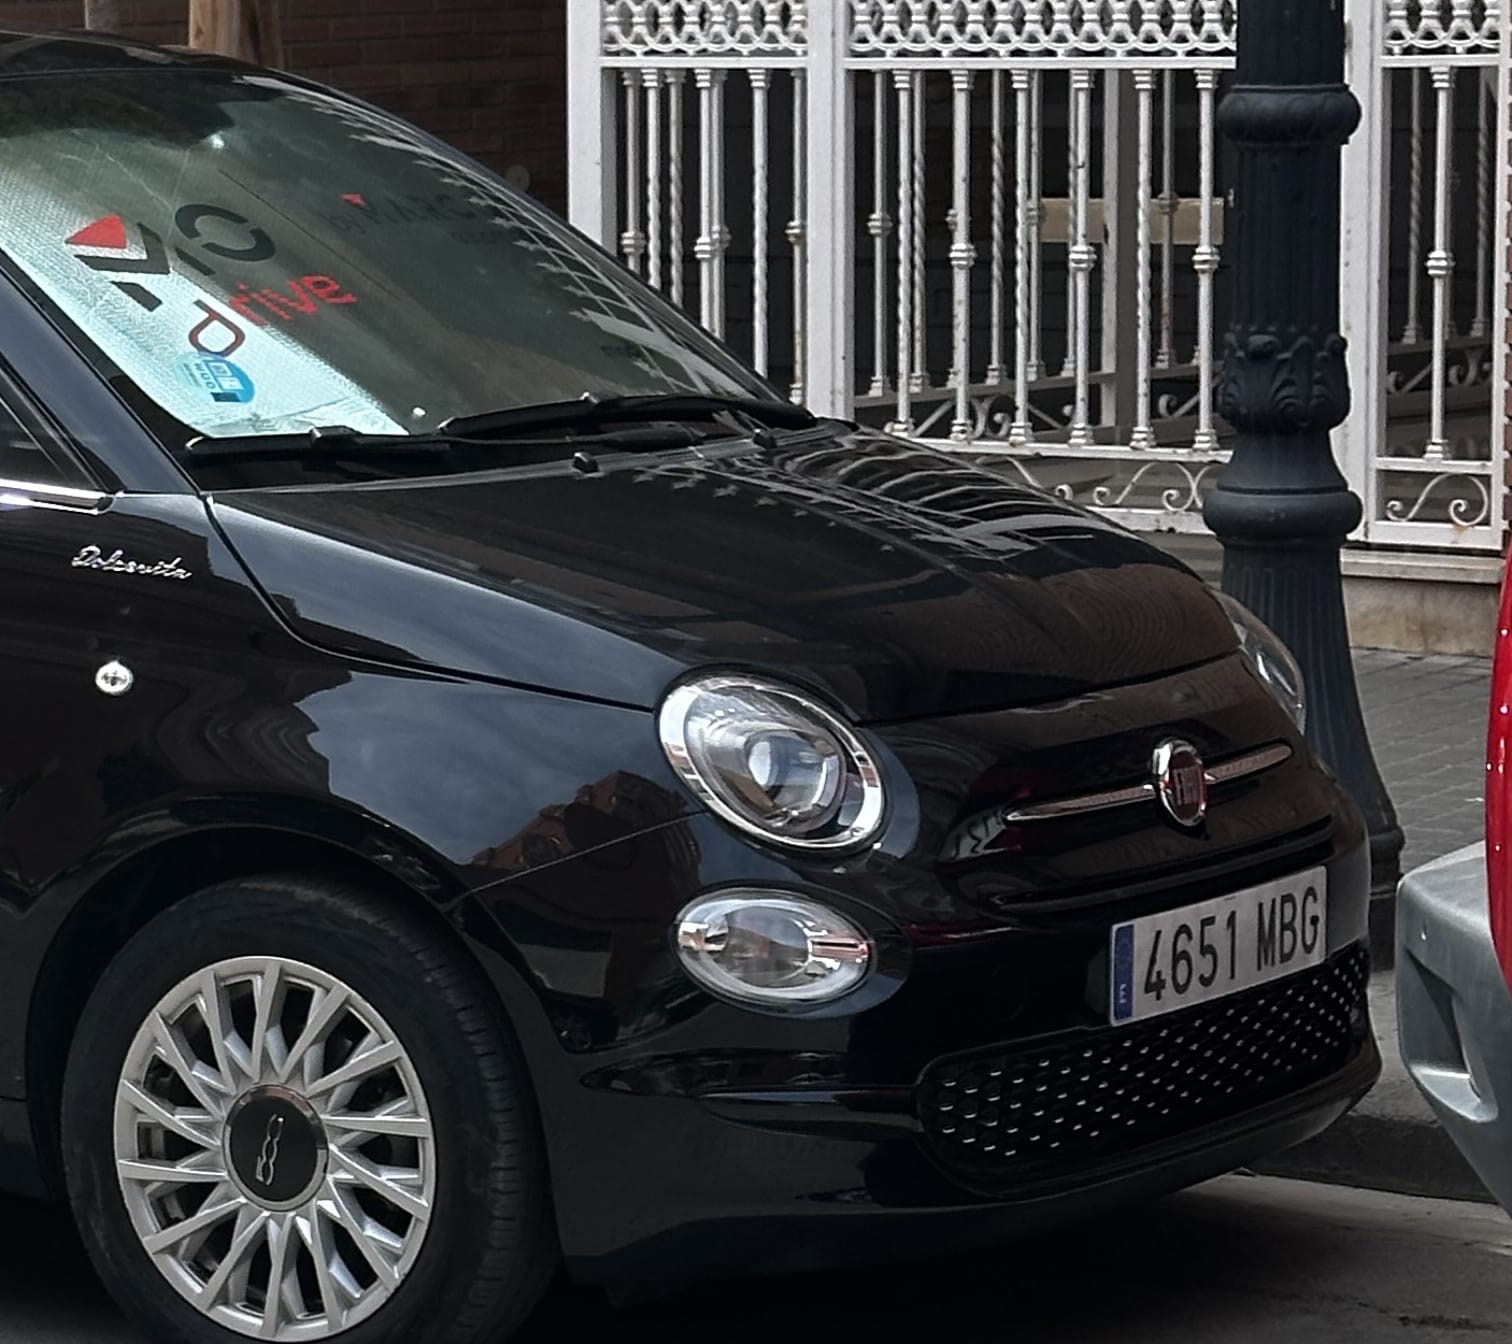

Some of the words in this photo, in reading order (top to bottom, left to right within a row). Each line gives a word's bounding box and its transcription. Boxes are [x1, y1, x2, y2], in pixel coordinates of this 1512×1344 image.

[188, 273, 357, 358] drive
[1144, 910, 1237, 1002] 4651
[1256, 885, 1321, 972] MBG
